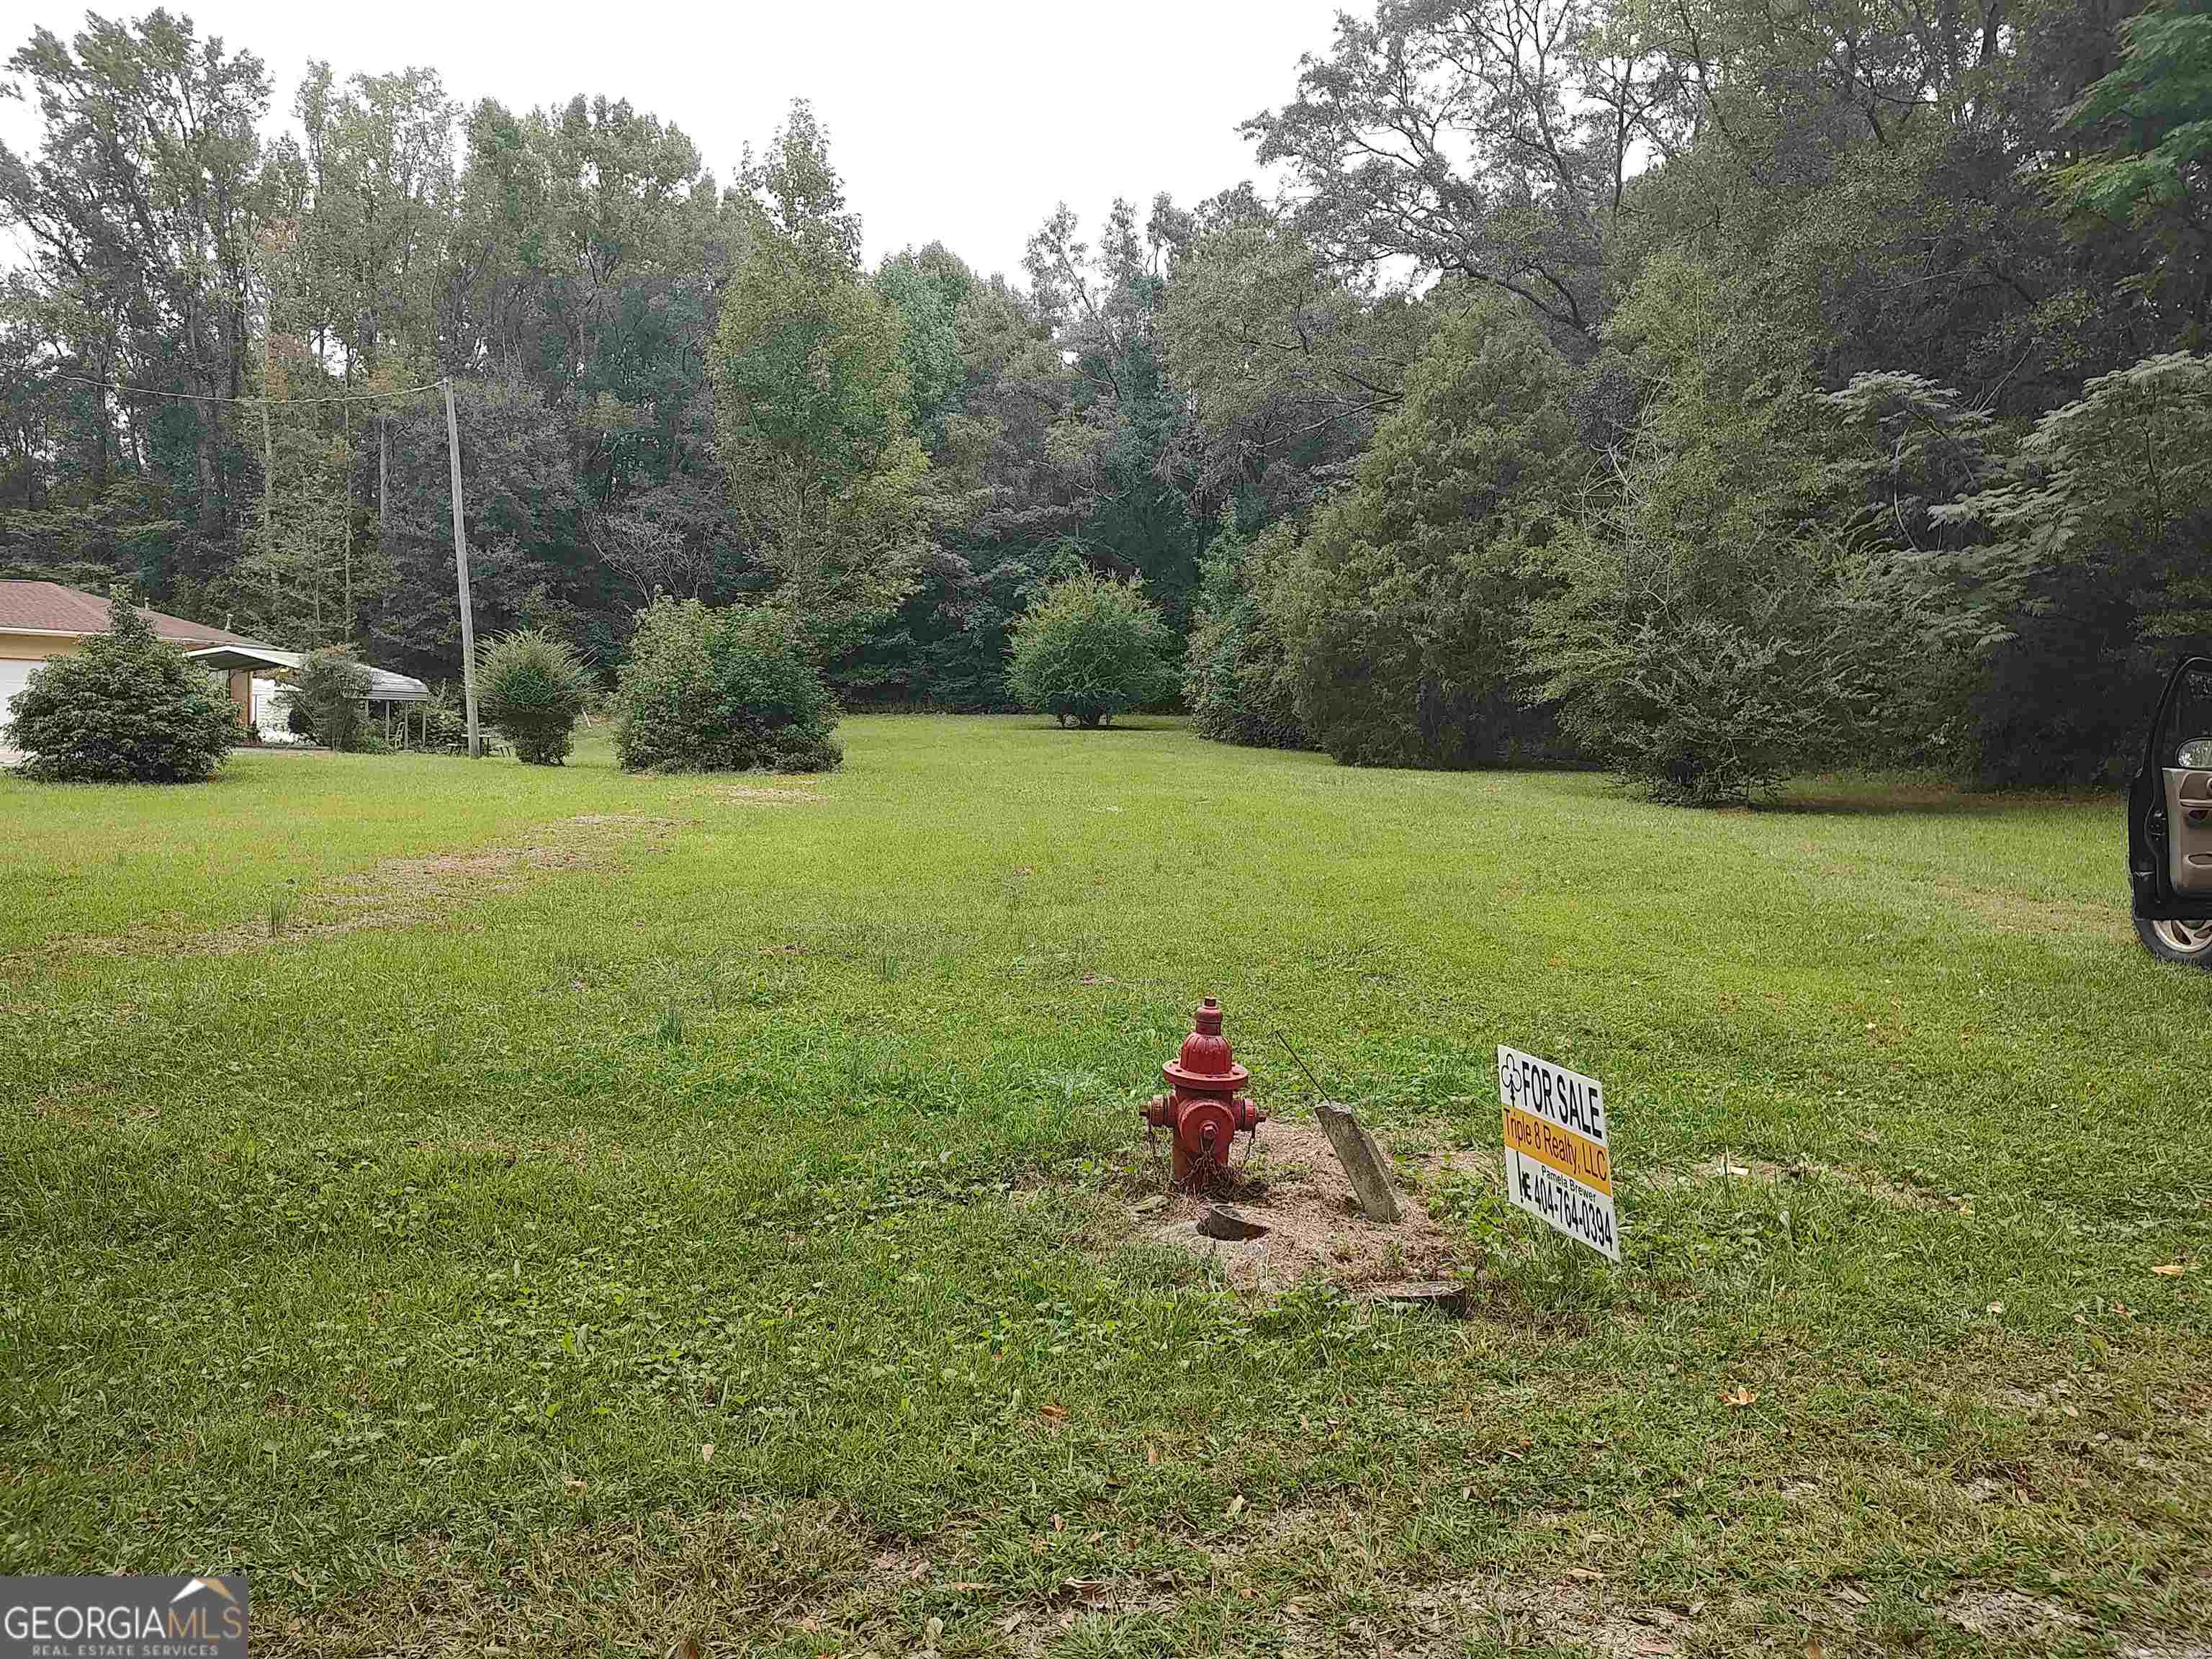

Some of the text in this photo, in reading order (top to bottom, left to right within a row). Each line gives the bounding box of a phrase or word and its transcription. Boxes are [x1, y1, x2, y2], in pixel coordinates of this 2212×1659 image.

[1522, 1061, 1602, 1138] FOR SALE
[1503, 1108, 1606, 1180] Triple 8 Realty, LLC
[1534, 1175, 1612, 1251] 404-764-0394
[1542, 1165, 1596, 1202] Pamela Brewer
